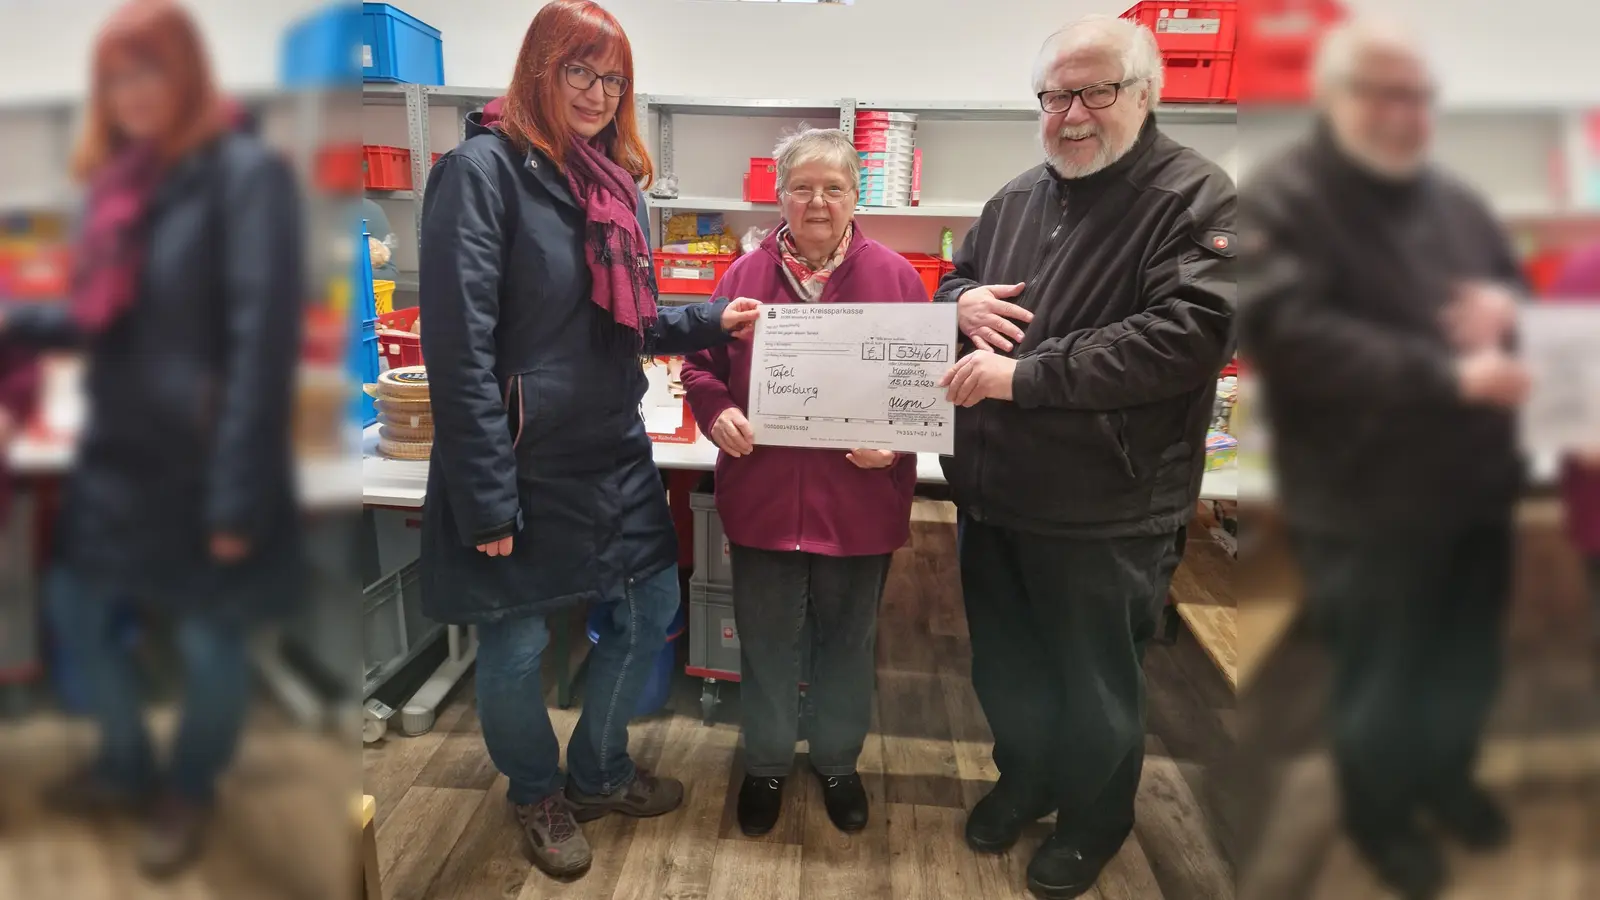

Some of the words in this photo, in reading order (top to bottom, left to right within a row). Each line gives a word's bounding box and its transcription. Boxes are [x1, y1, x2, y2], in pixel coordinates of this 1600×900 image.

[781, 307, 800, 315] Stadt-
[810, 307, 864, 316] Kreissparkasse
[896, 345, 942, 361] 534,61
[765, 364, 795, 380] Tafel
[767, 380, 819, 407] Moosburg
